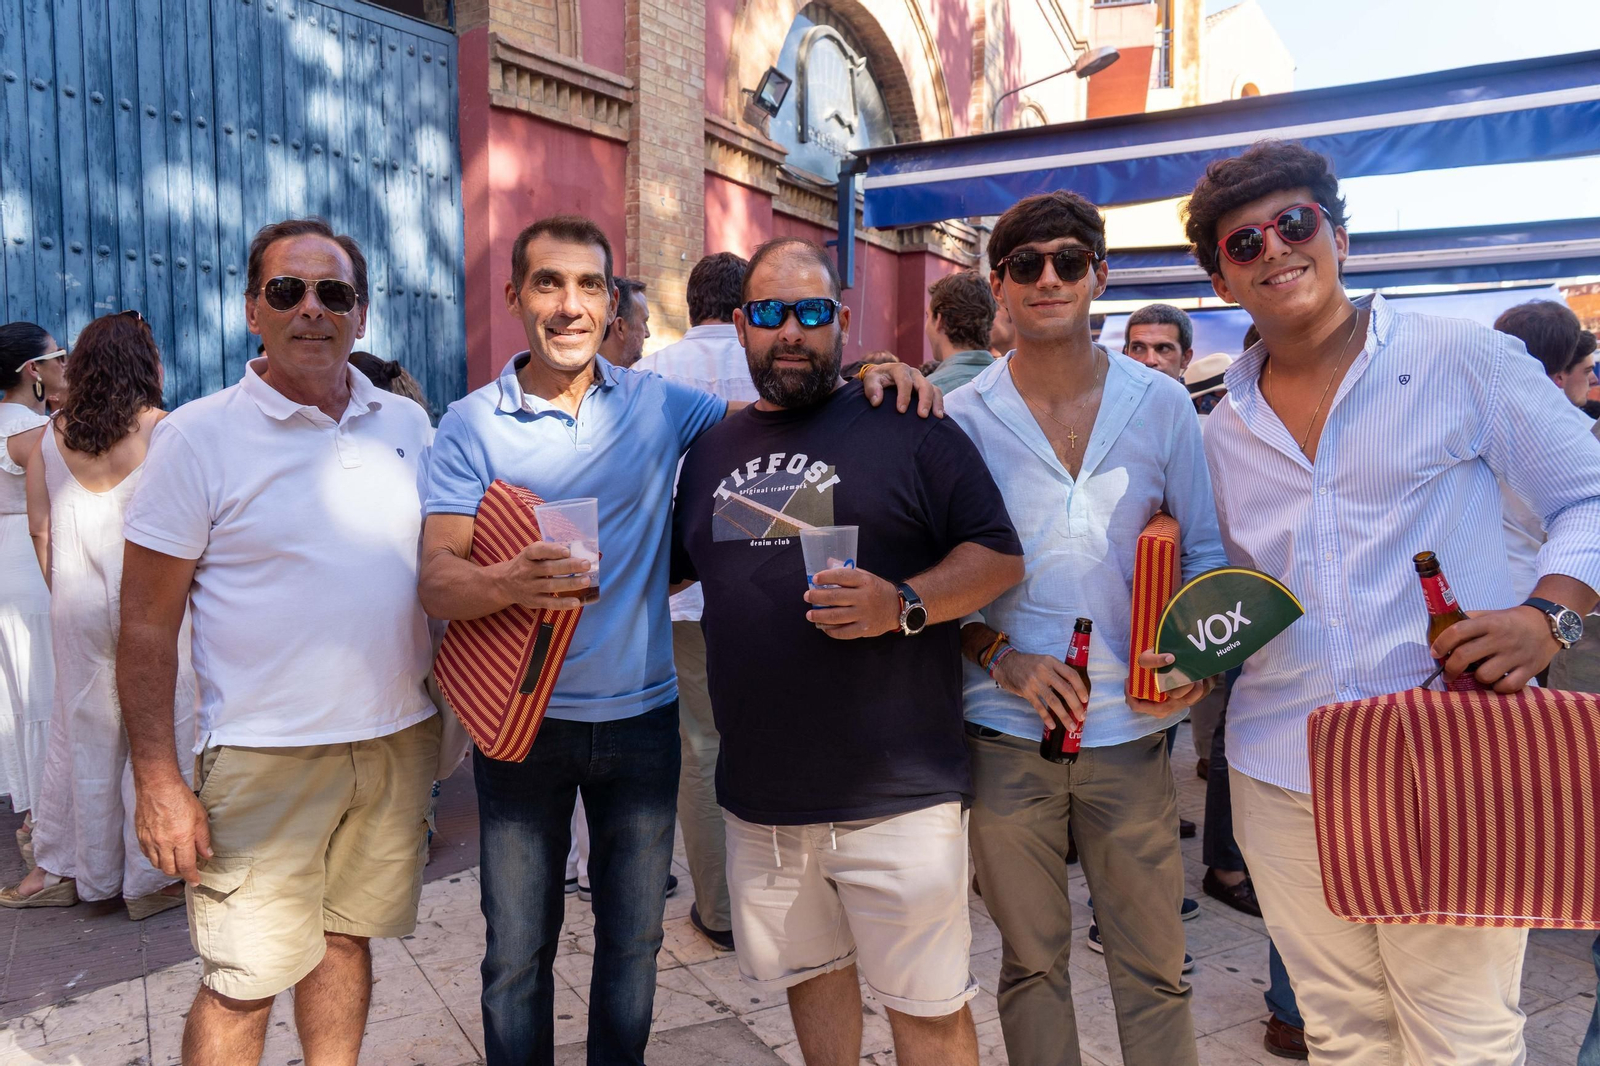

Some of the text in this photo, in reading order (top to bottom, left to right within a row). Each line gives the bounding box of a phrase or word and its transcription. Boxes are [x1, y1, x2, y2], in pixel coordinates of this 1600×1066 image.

[712, 452, 841, 501] TIFFOSI
[739, 483, 808, 496] original trademark
[750, 538, 790, 547] denim club
[1187, 601, 1252, 652] VOX
[1216, 639, 1241, 658] Huelva
